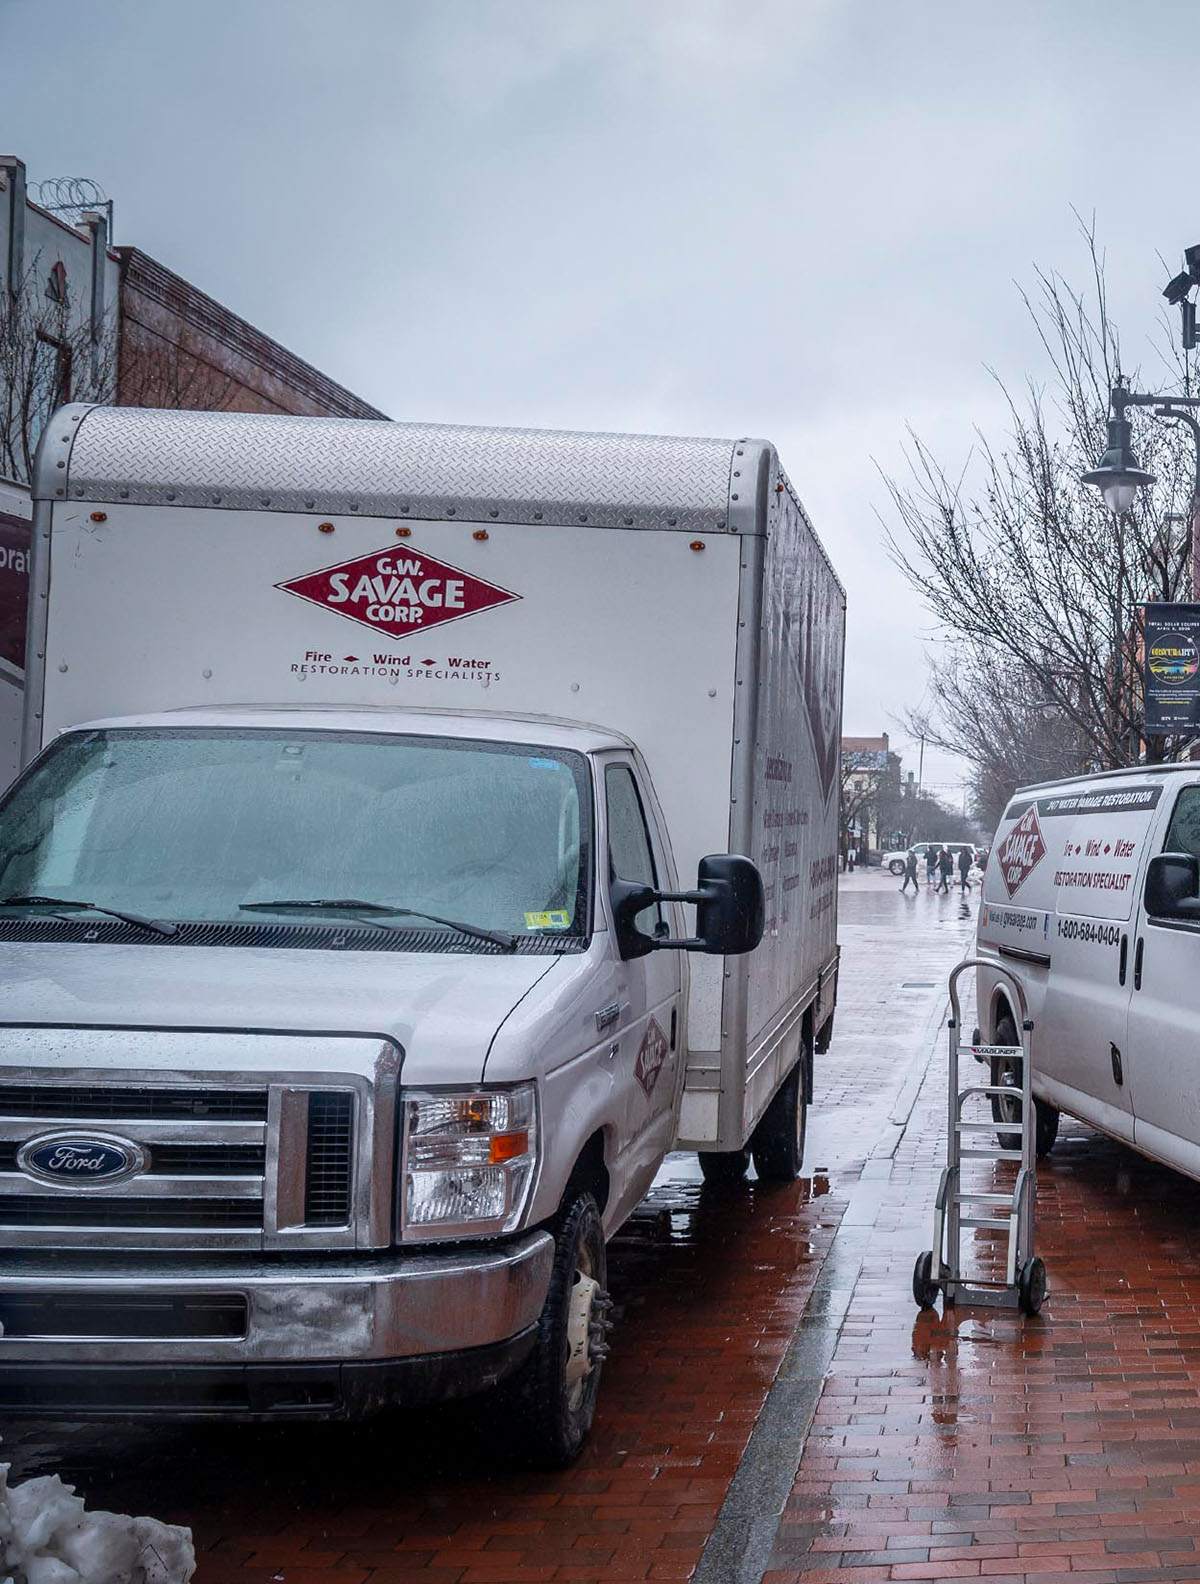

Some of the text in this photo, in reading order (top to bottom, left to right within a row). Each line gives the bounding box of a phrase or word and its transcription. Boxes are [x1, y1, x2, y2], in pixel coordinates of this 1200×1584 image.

[376, 557, 424, 577] G.W.
[327, 572, 465, 609] SAVAGE
[366, 604, 424, 624] CORP.
[305, 651, 491, 670] Fire Wind Water
[290, 663, 501, 682] RESTORATION SPECIALISTS
[1102, 791, 1154, 807] RESTORATION
[1002, 834, 1039, 867] SAVAGE
[1085, 839, 1102, 857] Wind
[1113, 838, 1136, 857] Water
[1092, 872, 1132, 891] SPECIALIST
[48, 1146, 105, 1171] Ford
